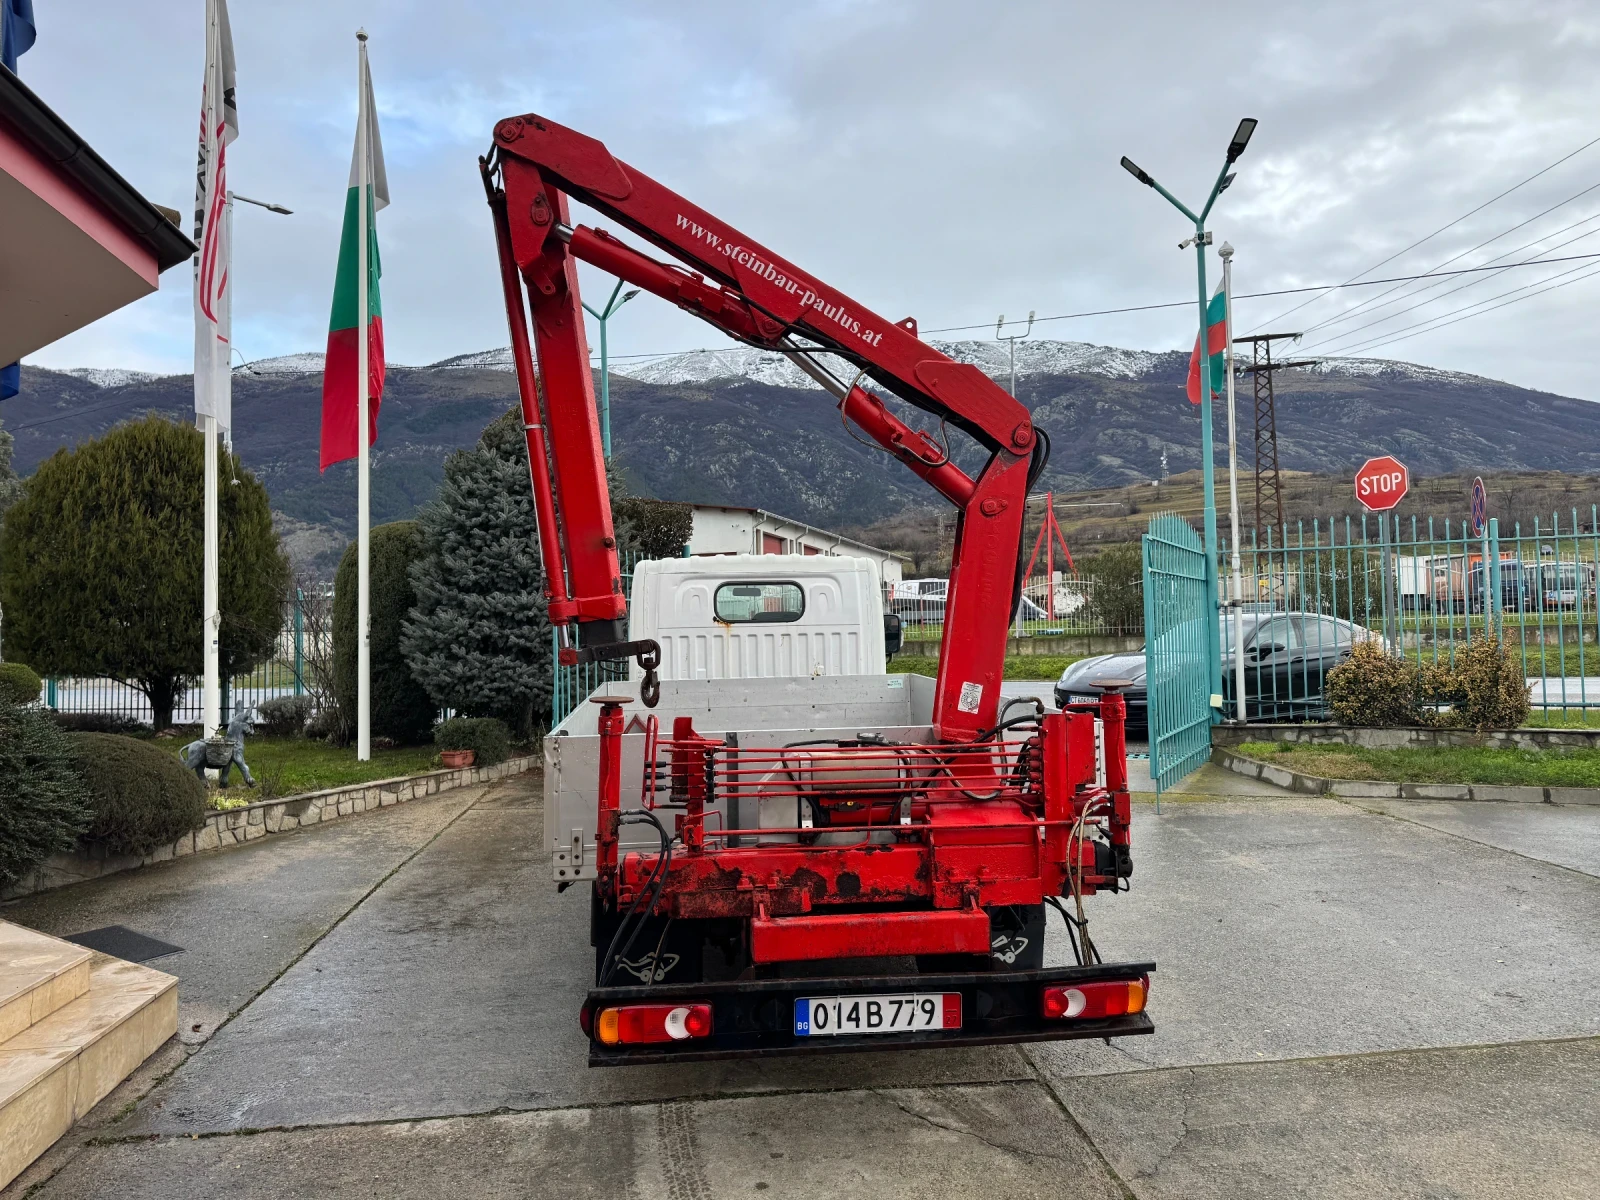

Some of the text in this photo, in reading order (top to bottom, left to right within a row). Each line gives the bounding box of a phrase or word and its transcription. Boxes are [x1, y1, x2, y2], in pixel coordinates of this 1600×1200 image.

[676, 213, 884, 348] www.steinbau-paulus.at
[1360, 472, 1402, 496] STOP
[797, 998, 957, 1031] BG 014B779 27
